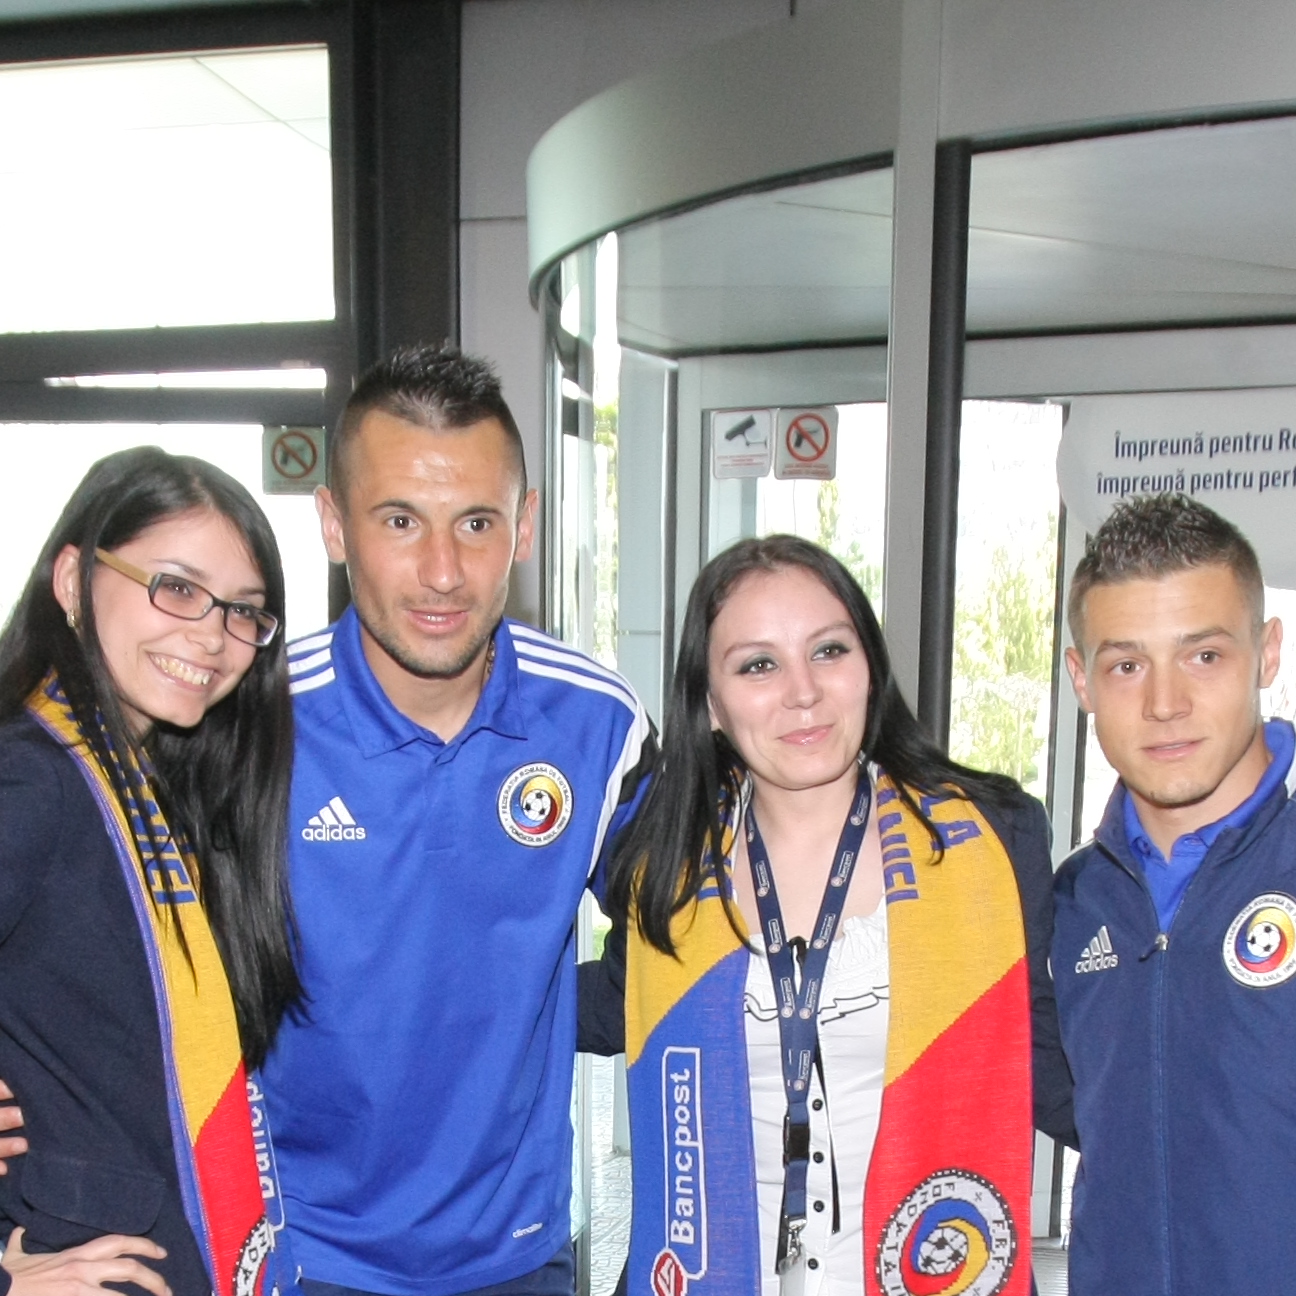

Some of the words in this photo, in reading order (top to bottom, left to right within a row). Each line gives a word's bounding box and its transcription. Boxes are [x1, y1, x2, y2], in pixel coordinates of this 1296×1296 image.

[1114, 431, 1204, 462] Împreună
[1209, 433, 1273, 459] pentru
[1096, 469, 1185, 498] împreună
[1190, 469, 1253, 495] pentru
[301, 824, 367, 841] adidas
[1075, 953, 1119, 974] adidas
[670, 1067, 700, 1245] Bancpost
